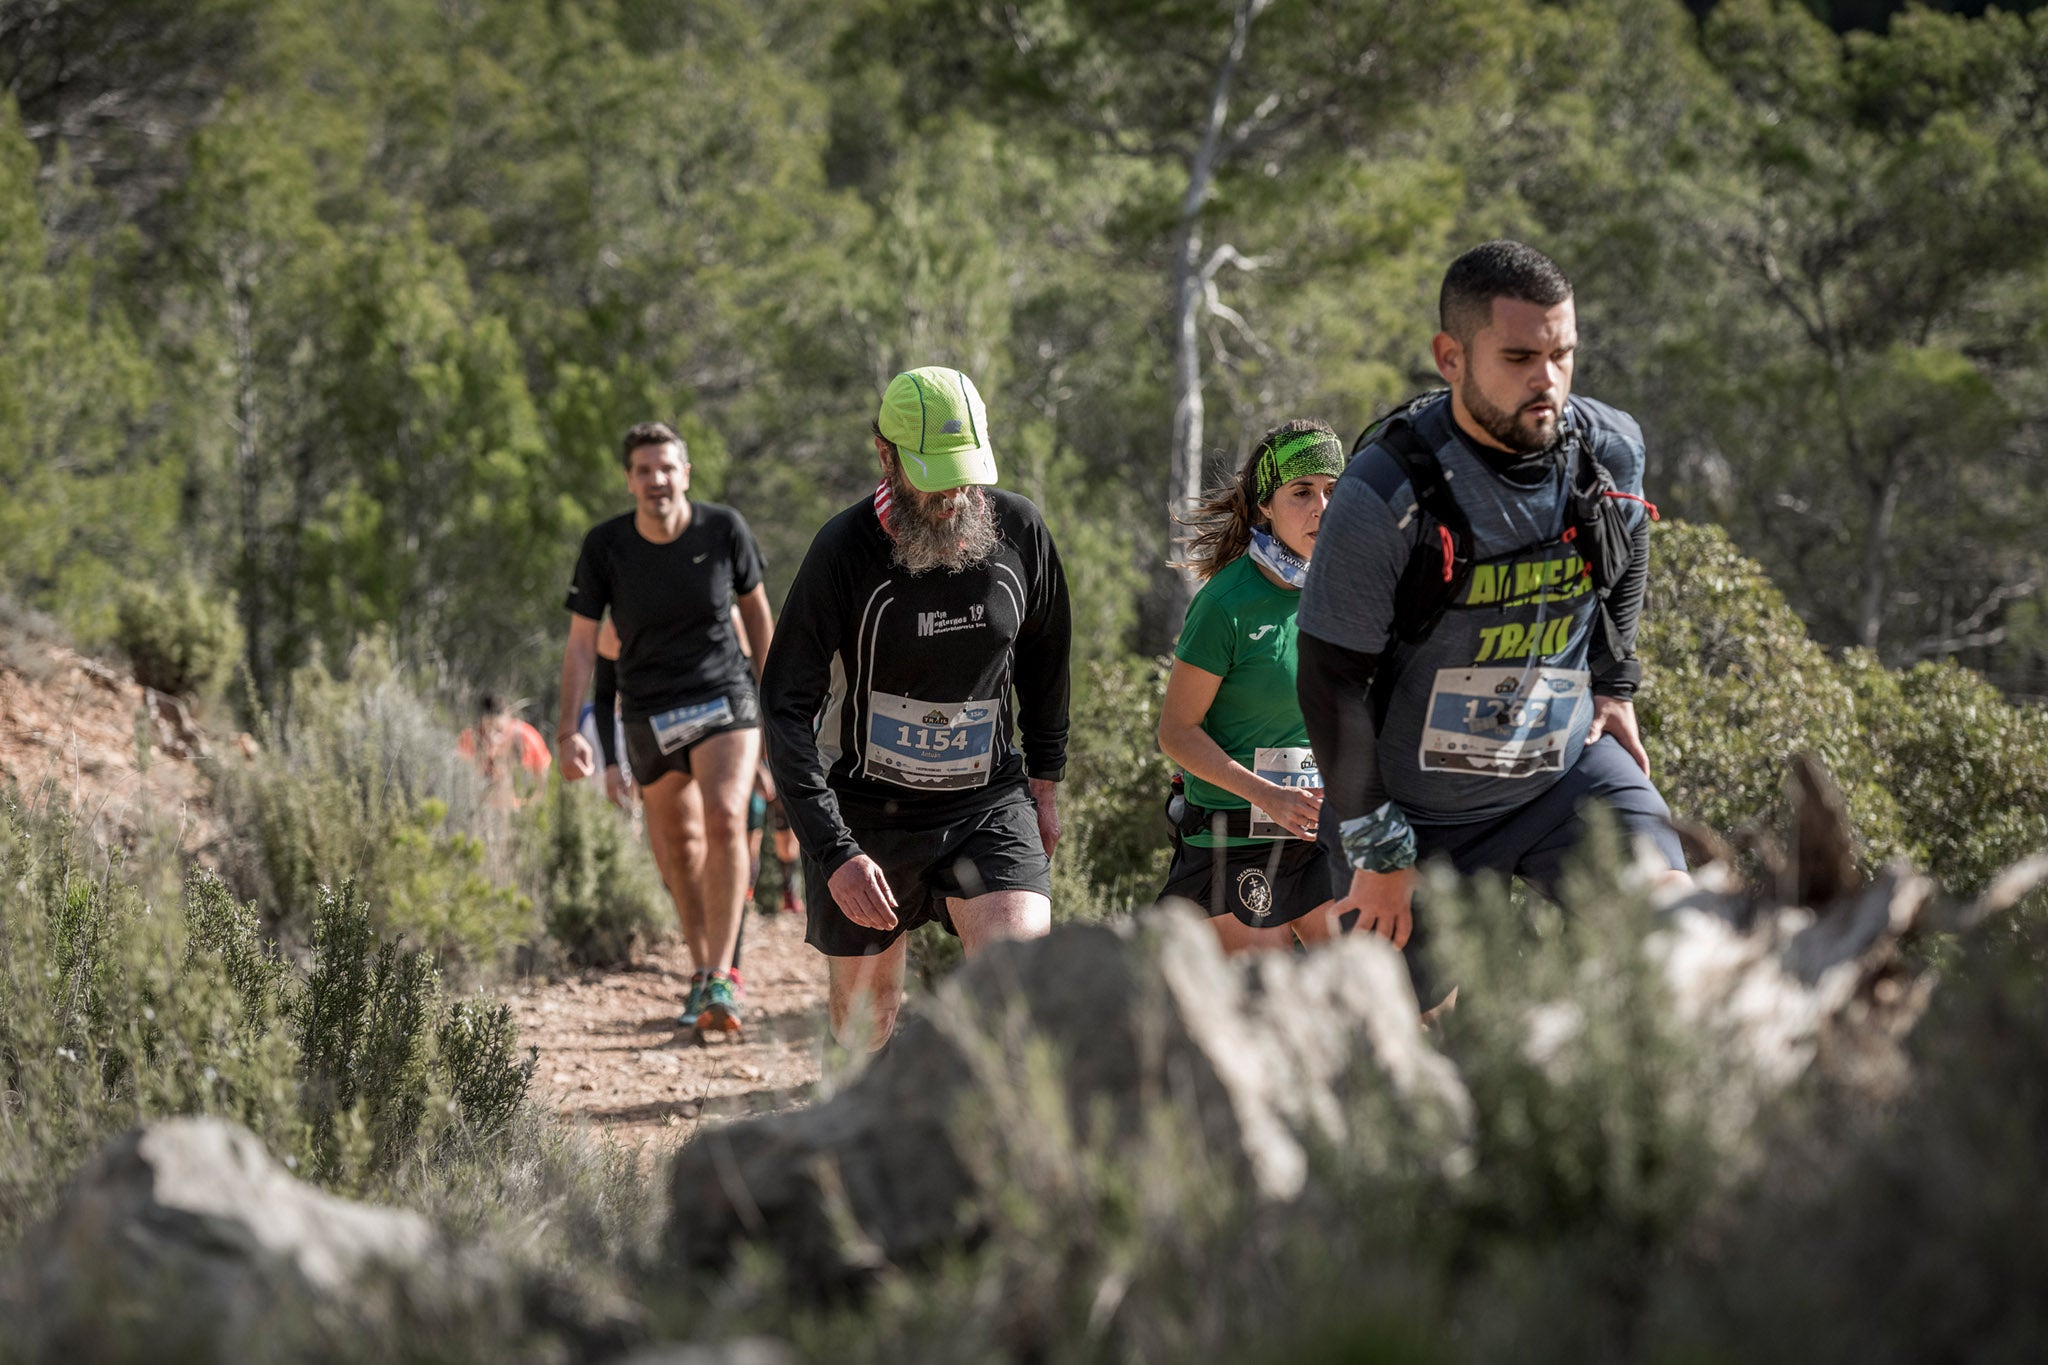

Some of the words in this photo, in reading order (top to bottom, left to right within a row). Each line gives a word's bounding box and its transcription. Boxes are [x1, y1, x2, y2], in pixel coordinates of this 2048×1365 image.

[923, 717, 948, 725] TRAIL
[896, 725, 968, 751] 1154
[1236, 868, 1264, 882] DESNIVEL
